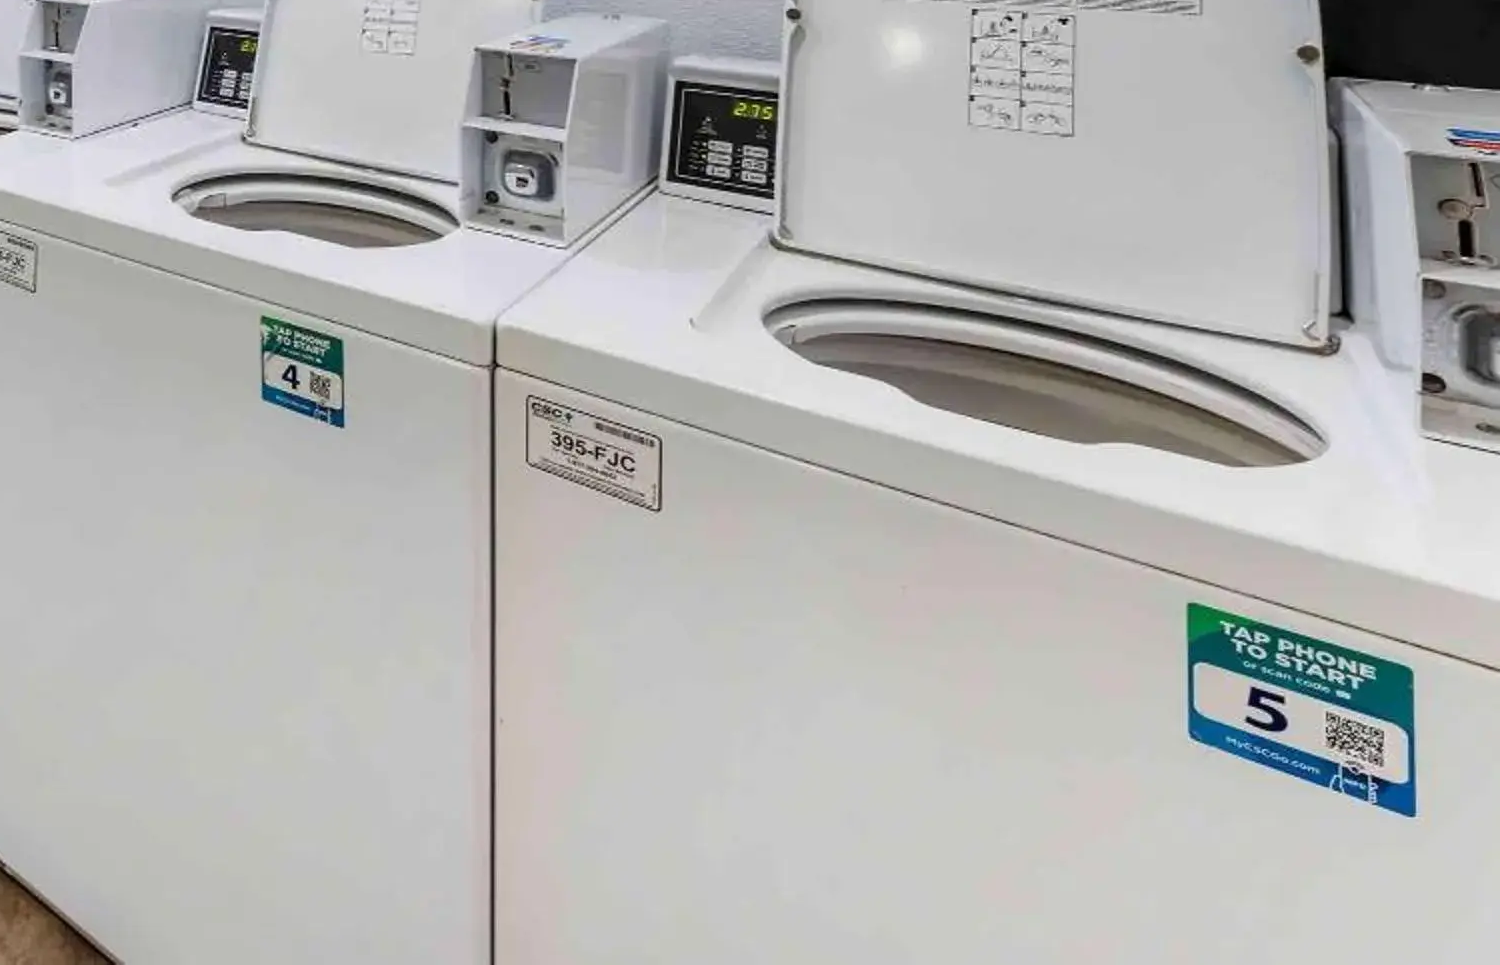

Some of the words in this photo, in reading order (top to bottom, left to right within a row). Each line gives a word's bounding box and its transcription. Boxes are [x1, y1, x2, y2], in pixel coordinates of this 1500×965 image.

[282, 364, 300, 390] 4
[551, 430, 636, 473] 395-FJC
[1220, 620, 1271, 644] TAP
[1277, 637, 1377, 681] PHONE
[1231, 638, 1267, 660] TO
[1275, 652, 1366, 691] START
[1243, 660, 1257, 671] or
[1261, 666, 1293, 682] scan
[1295, 676, 1331, 694] code
[1245, 686, 1288, 733] 5
